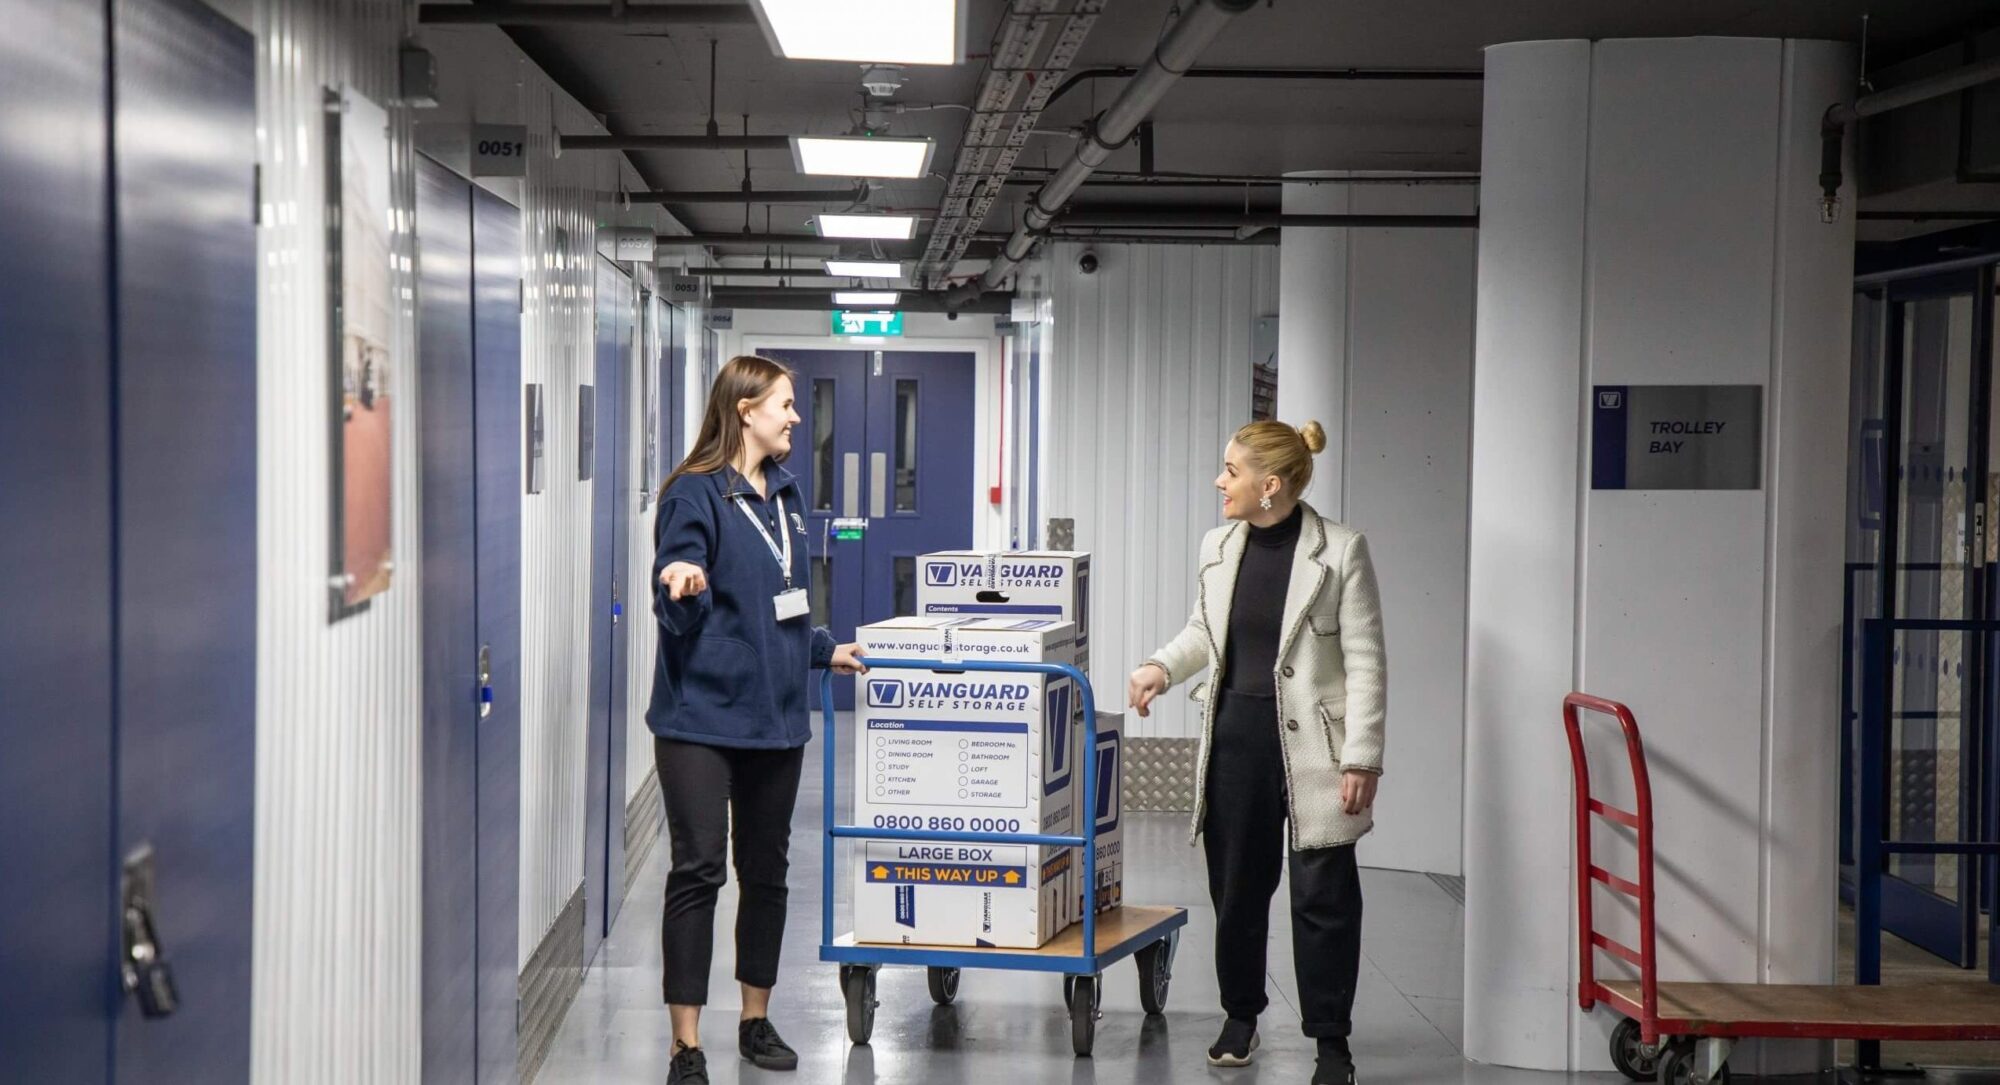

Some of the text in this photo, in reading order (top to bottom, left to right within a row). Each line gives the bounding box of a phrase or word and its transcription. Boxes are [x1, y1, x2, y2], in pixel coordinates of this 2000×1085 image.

[478, 140, 523, 157] 0051
[620, 238, 649, 249] 0052
[674, 283, 698, 293] 0053
[1649, 421, 1726, 435] TROLLEY
[1649, 441, 1684, 454] BAY
[960, 563, 1064, 579] VAGUARD
[960, 578, 983, 588] SEL
[927, 605, 959, 613] Contents
[907, 681, 1030, 701] VANGUARD
[907, 699, 1026, 712] SELF STORAGE
[870, 720, 905, 730] Location
[888, 738, 933, 746] LIVING ROOM
[971, 740, 1006, 748] BEDROOM
[970, 765, 988, 773] LOFT
[970, 778, 999, 786] GARAGE
[887, 788, 911, 796] OTHER
[873, 814, 1020, 833] 0800 860 0000
[898, 846, 993, 862] LARGE BOX
[894, 866, 998, 883] THIS WAY UP
